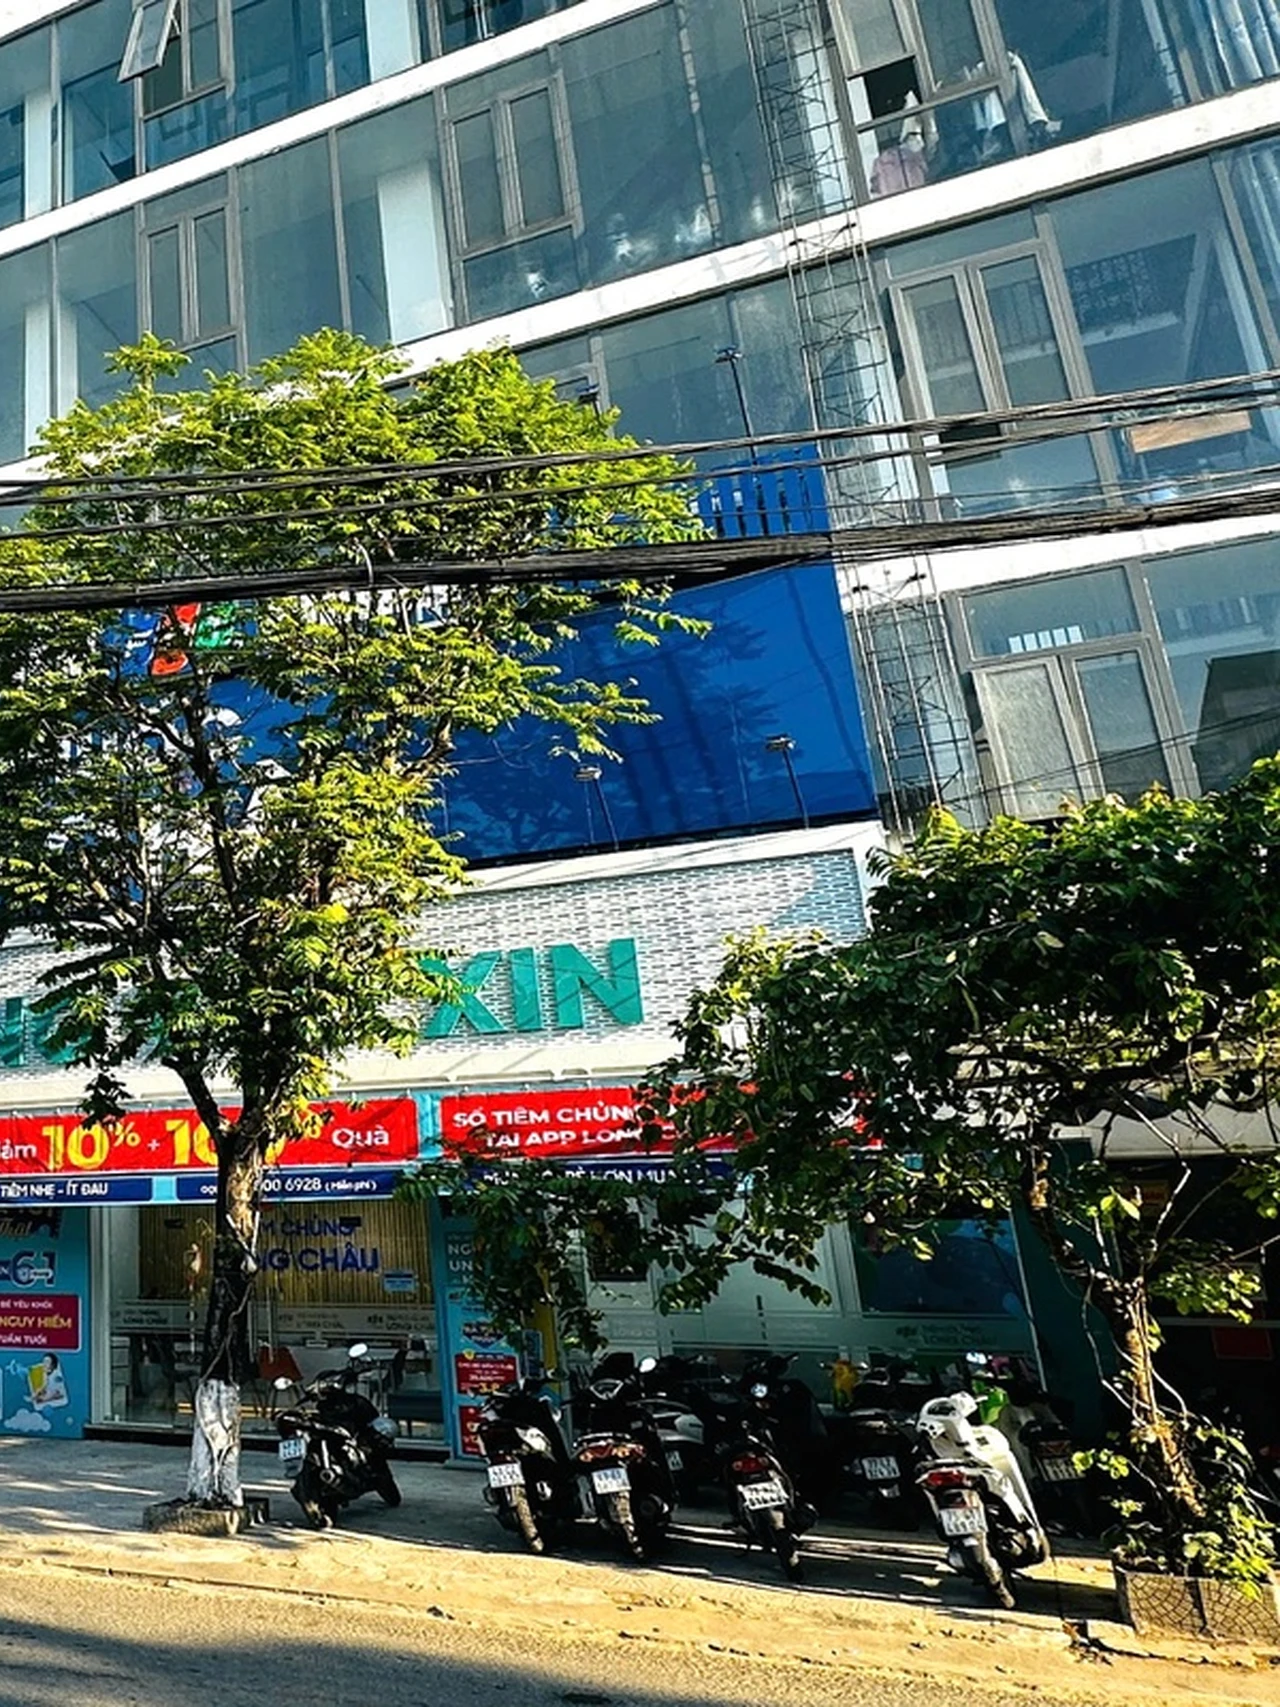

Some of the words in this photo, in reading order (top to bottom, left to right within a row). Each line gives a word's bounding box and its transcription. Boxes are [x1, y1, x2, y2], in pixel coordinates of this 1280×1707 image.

[419, 937, 644, 1039] XIN
[491, 1106, 550, 1125] TIÊM
[332, 1125, 389, 1147] Quà
[285, 1177, 322, 1192] 6928
[298, 1241, 380, 1273] CHÂU
